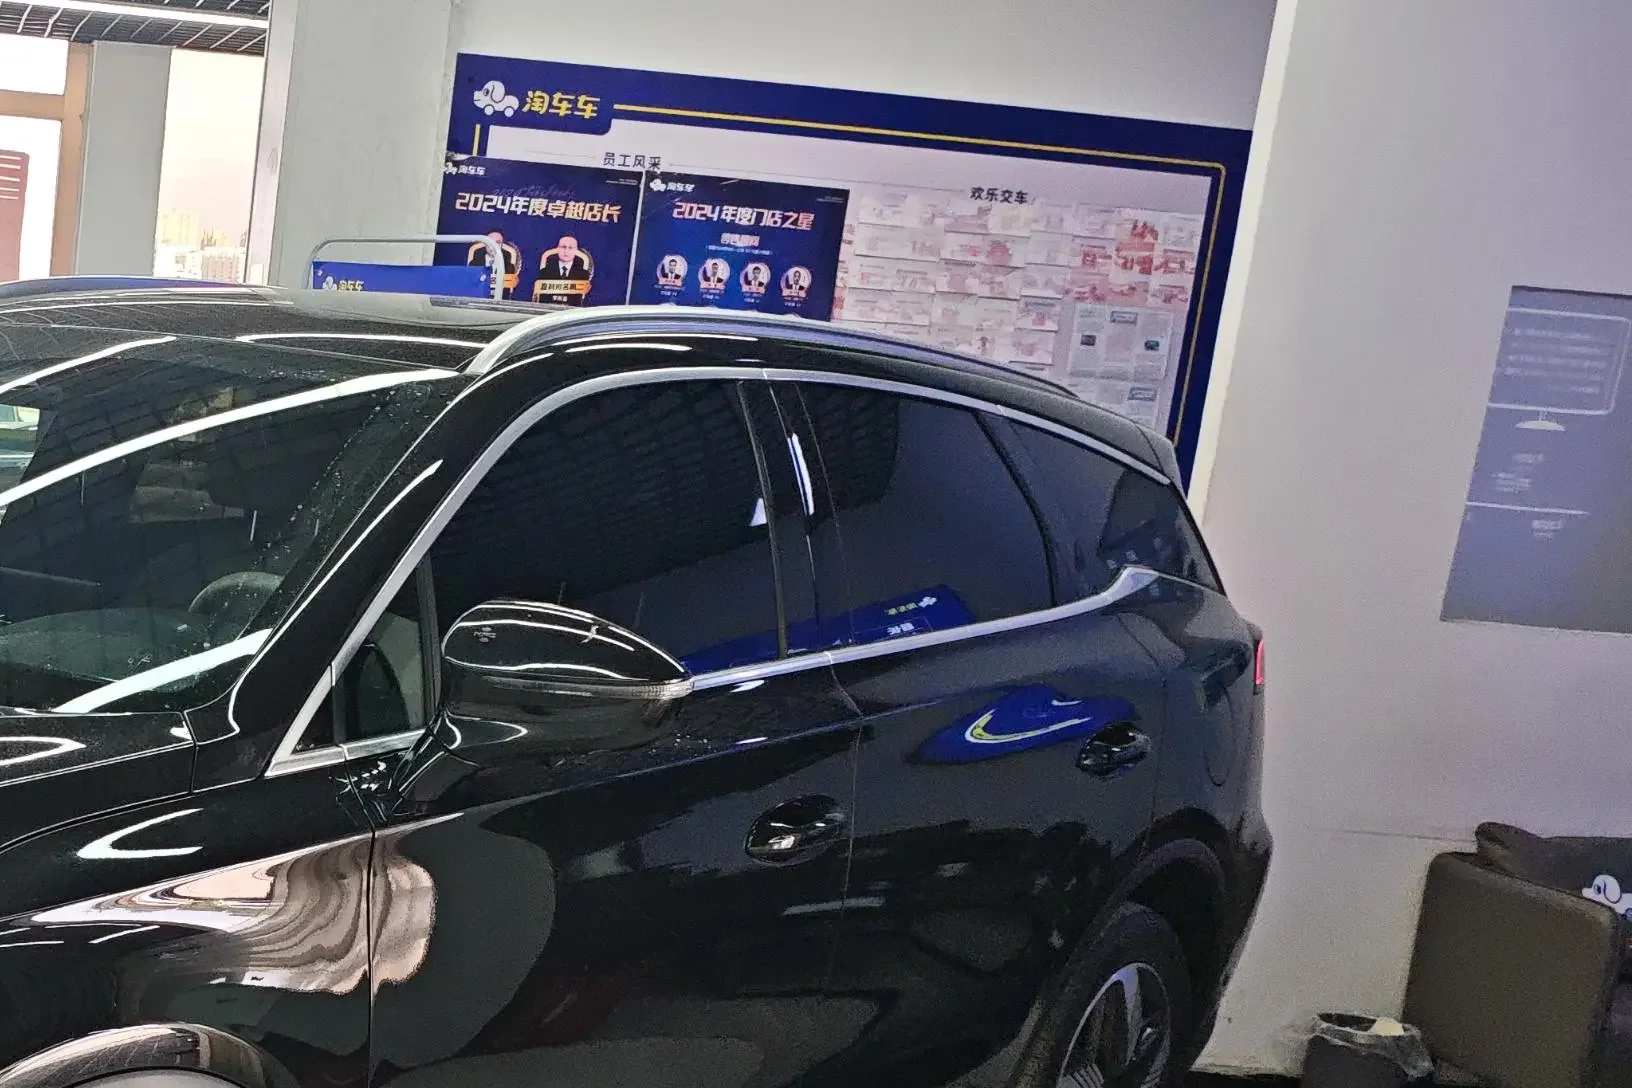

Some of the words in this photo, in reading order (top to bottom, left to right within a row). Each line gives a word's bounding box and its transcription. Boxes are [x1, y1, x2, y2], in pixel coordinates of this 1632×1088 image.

[522, 90, 601, 119] 淘车车
[602, 151, 662, 171] 员工风采
[455, 191, 622, 224] 2024年度卓越店长
[969, 186, 1029, 205] 欢乐交车
[672, 201, 816, 231] 2024年度门店之星
